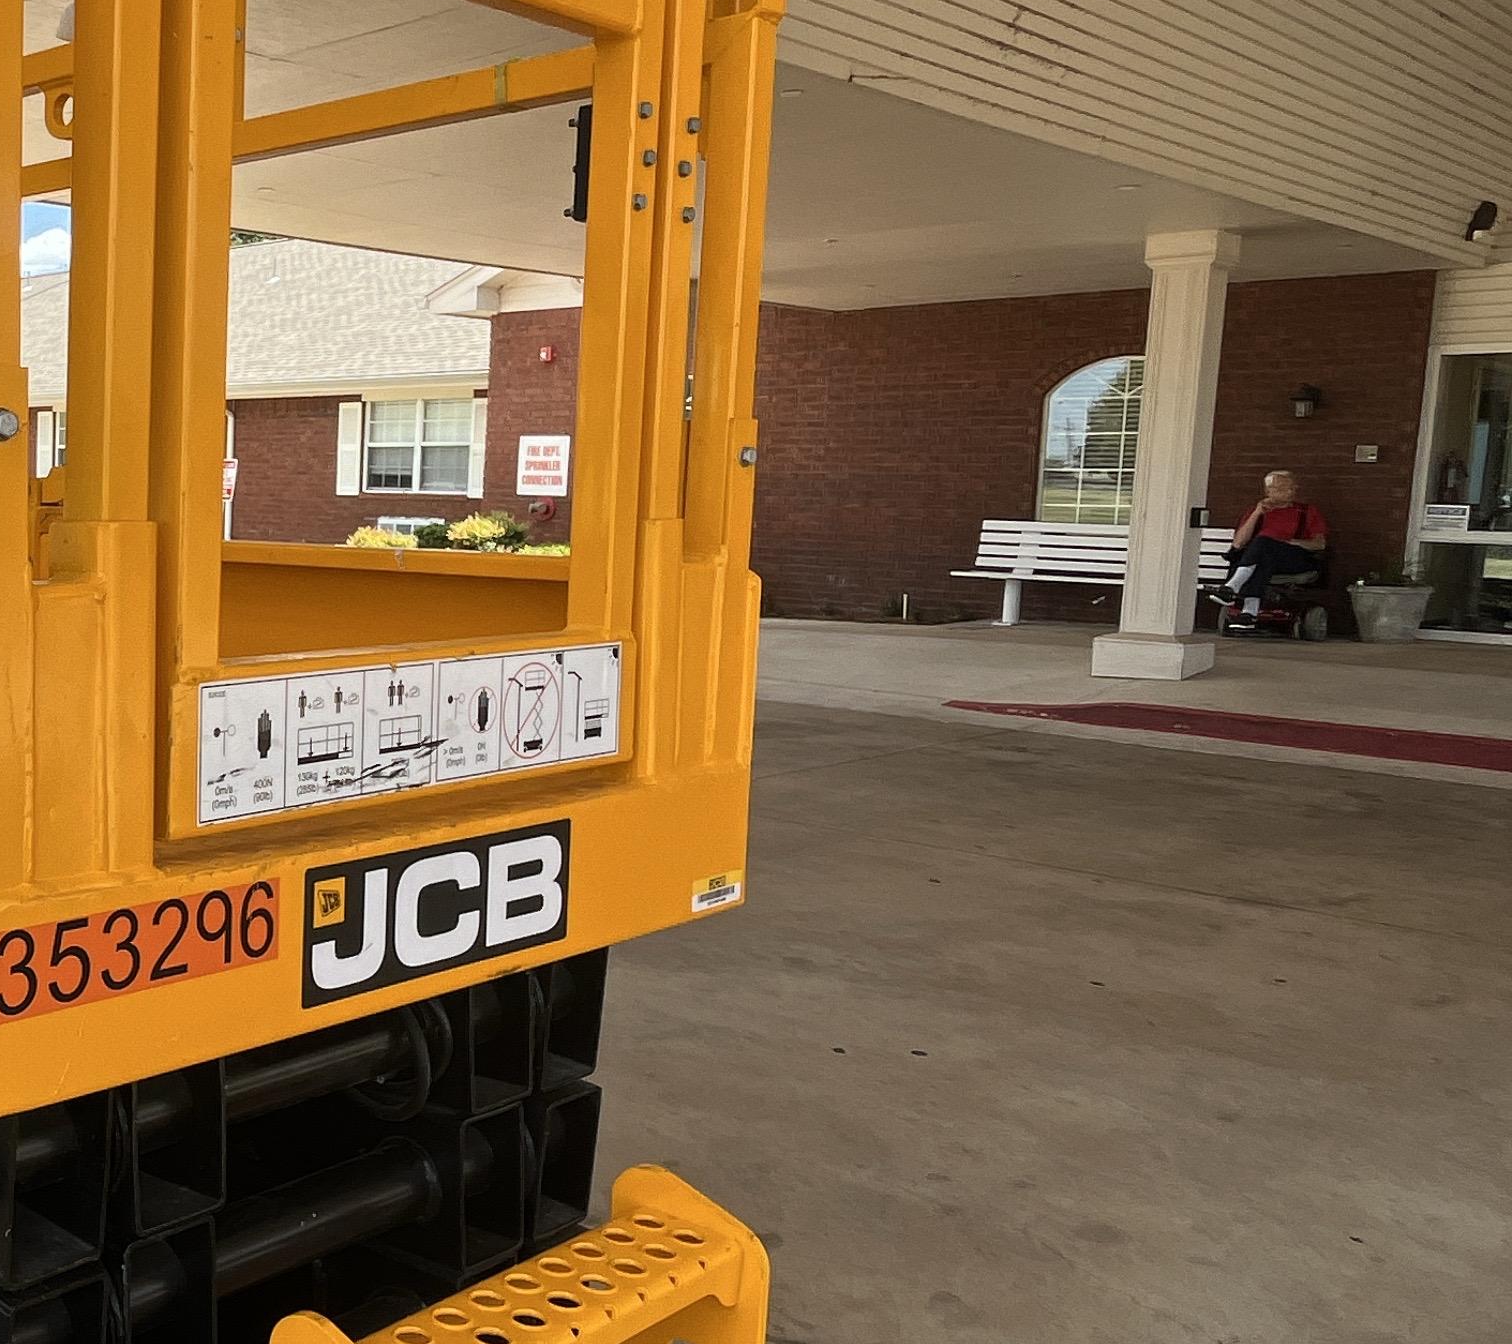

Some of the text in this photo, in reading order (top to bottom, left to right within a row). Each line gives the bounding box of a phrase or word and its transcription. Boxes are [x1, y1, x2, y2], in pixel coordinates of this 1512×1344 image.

[527, 446, 541, 457] FIRE
[524, 460, 561, 471] SPRINKLER
[521, 475, 563, 486] CONNECTION
[311, 834, 564, 991] JCB
